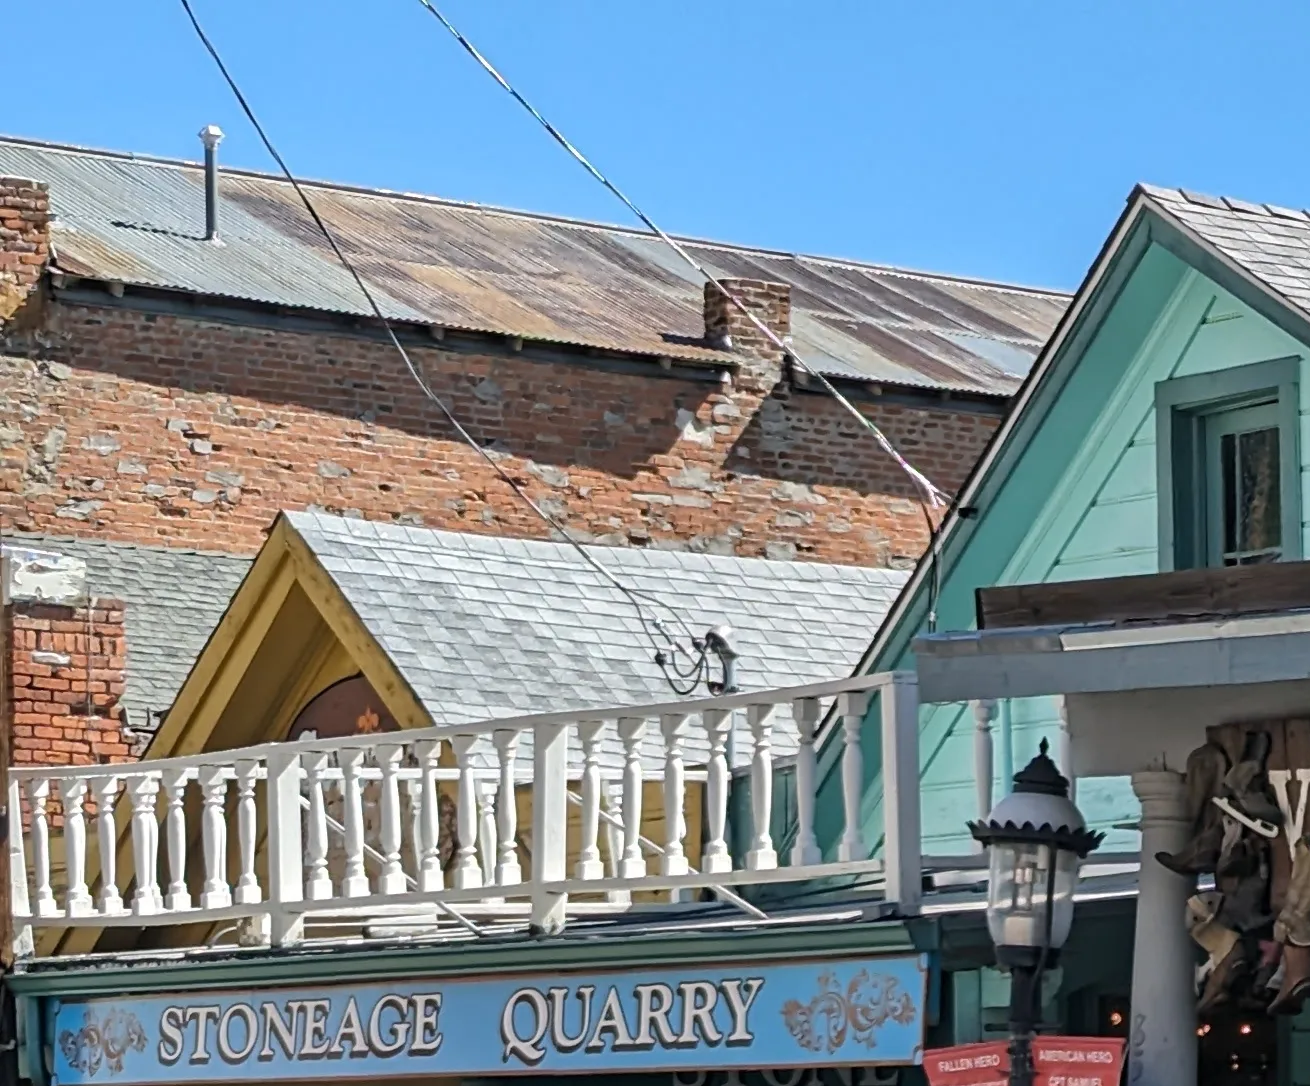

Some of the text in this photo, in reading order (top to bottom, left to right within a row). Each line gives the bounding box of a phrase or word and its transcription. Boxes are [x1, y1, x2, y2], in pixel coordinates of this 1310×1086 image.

[156, 977, 766, 1065] STONEAGE QUARRY
[939, 1054, 1001, 1073] FALLEN HERO
[1038, 1050, 1113, 1063] AMERICAN HERO
